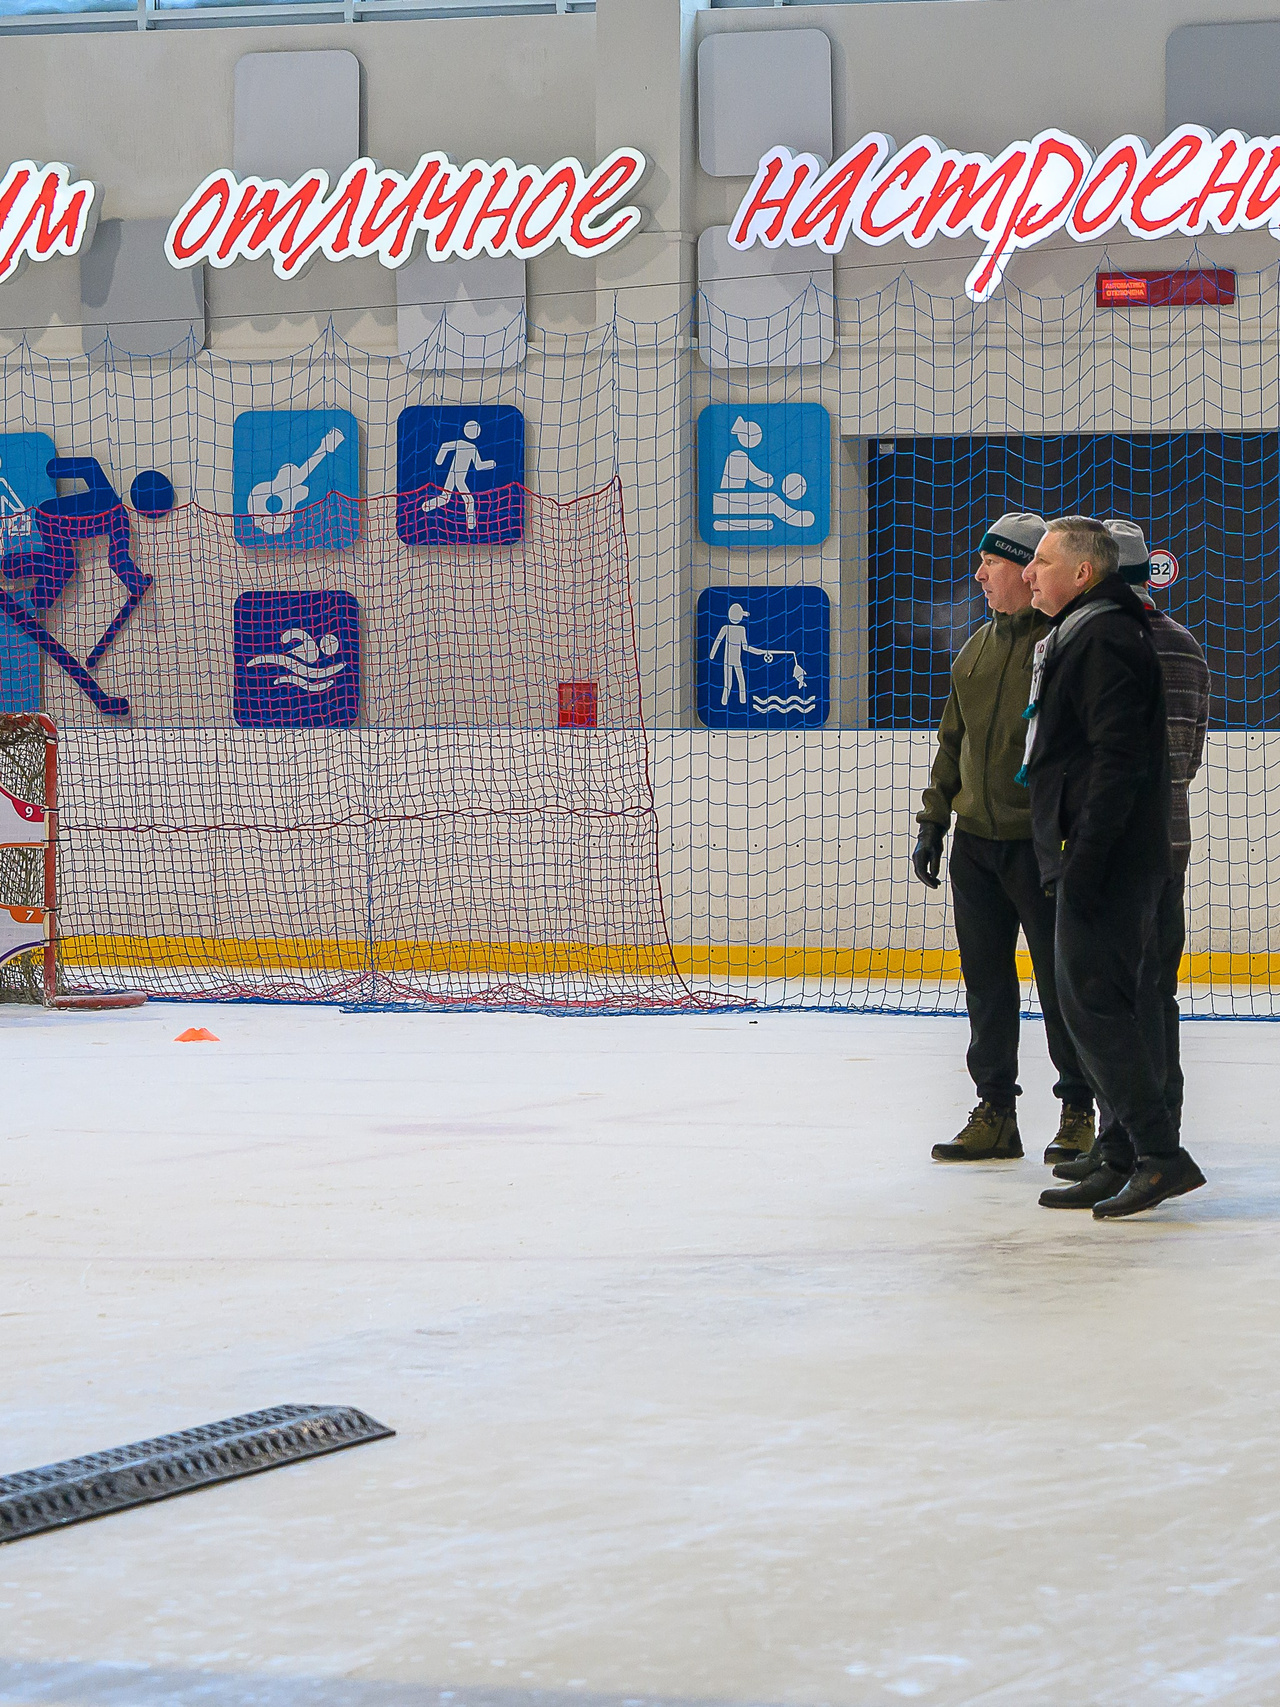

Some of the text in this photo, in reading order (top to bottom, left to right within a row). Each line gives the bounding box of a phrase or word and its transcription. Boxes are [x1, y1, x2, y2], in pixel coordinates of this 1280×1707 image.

[172, 156, 637, 271] отличное
[25, 806, 34, 818] 9
[25, 910, 34, 921] 7
